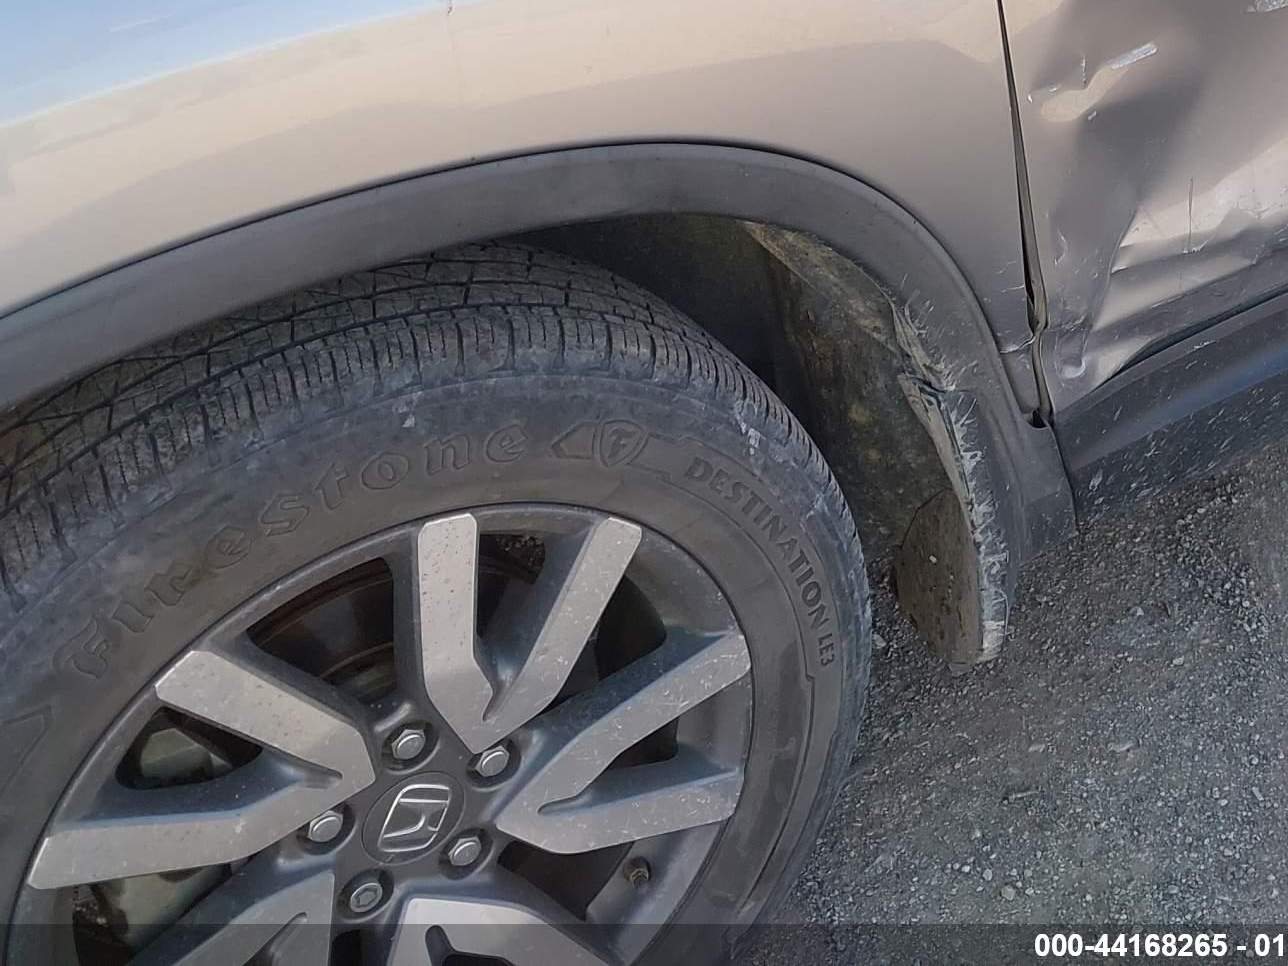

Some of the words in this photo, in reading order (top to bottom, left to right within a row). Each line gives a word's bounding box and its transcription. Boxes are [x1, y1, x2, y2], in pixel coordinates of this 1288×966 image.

[53, 418, 528, 679] Firestone
[683, 457, 831, 631] DESTINATION
[816, 632, 836, 668] LE3
